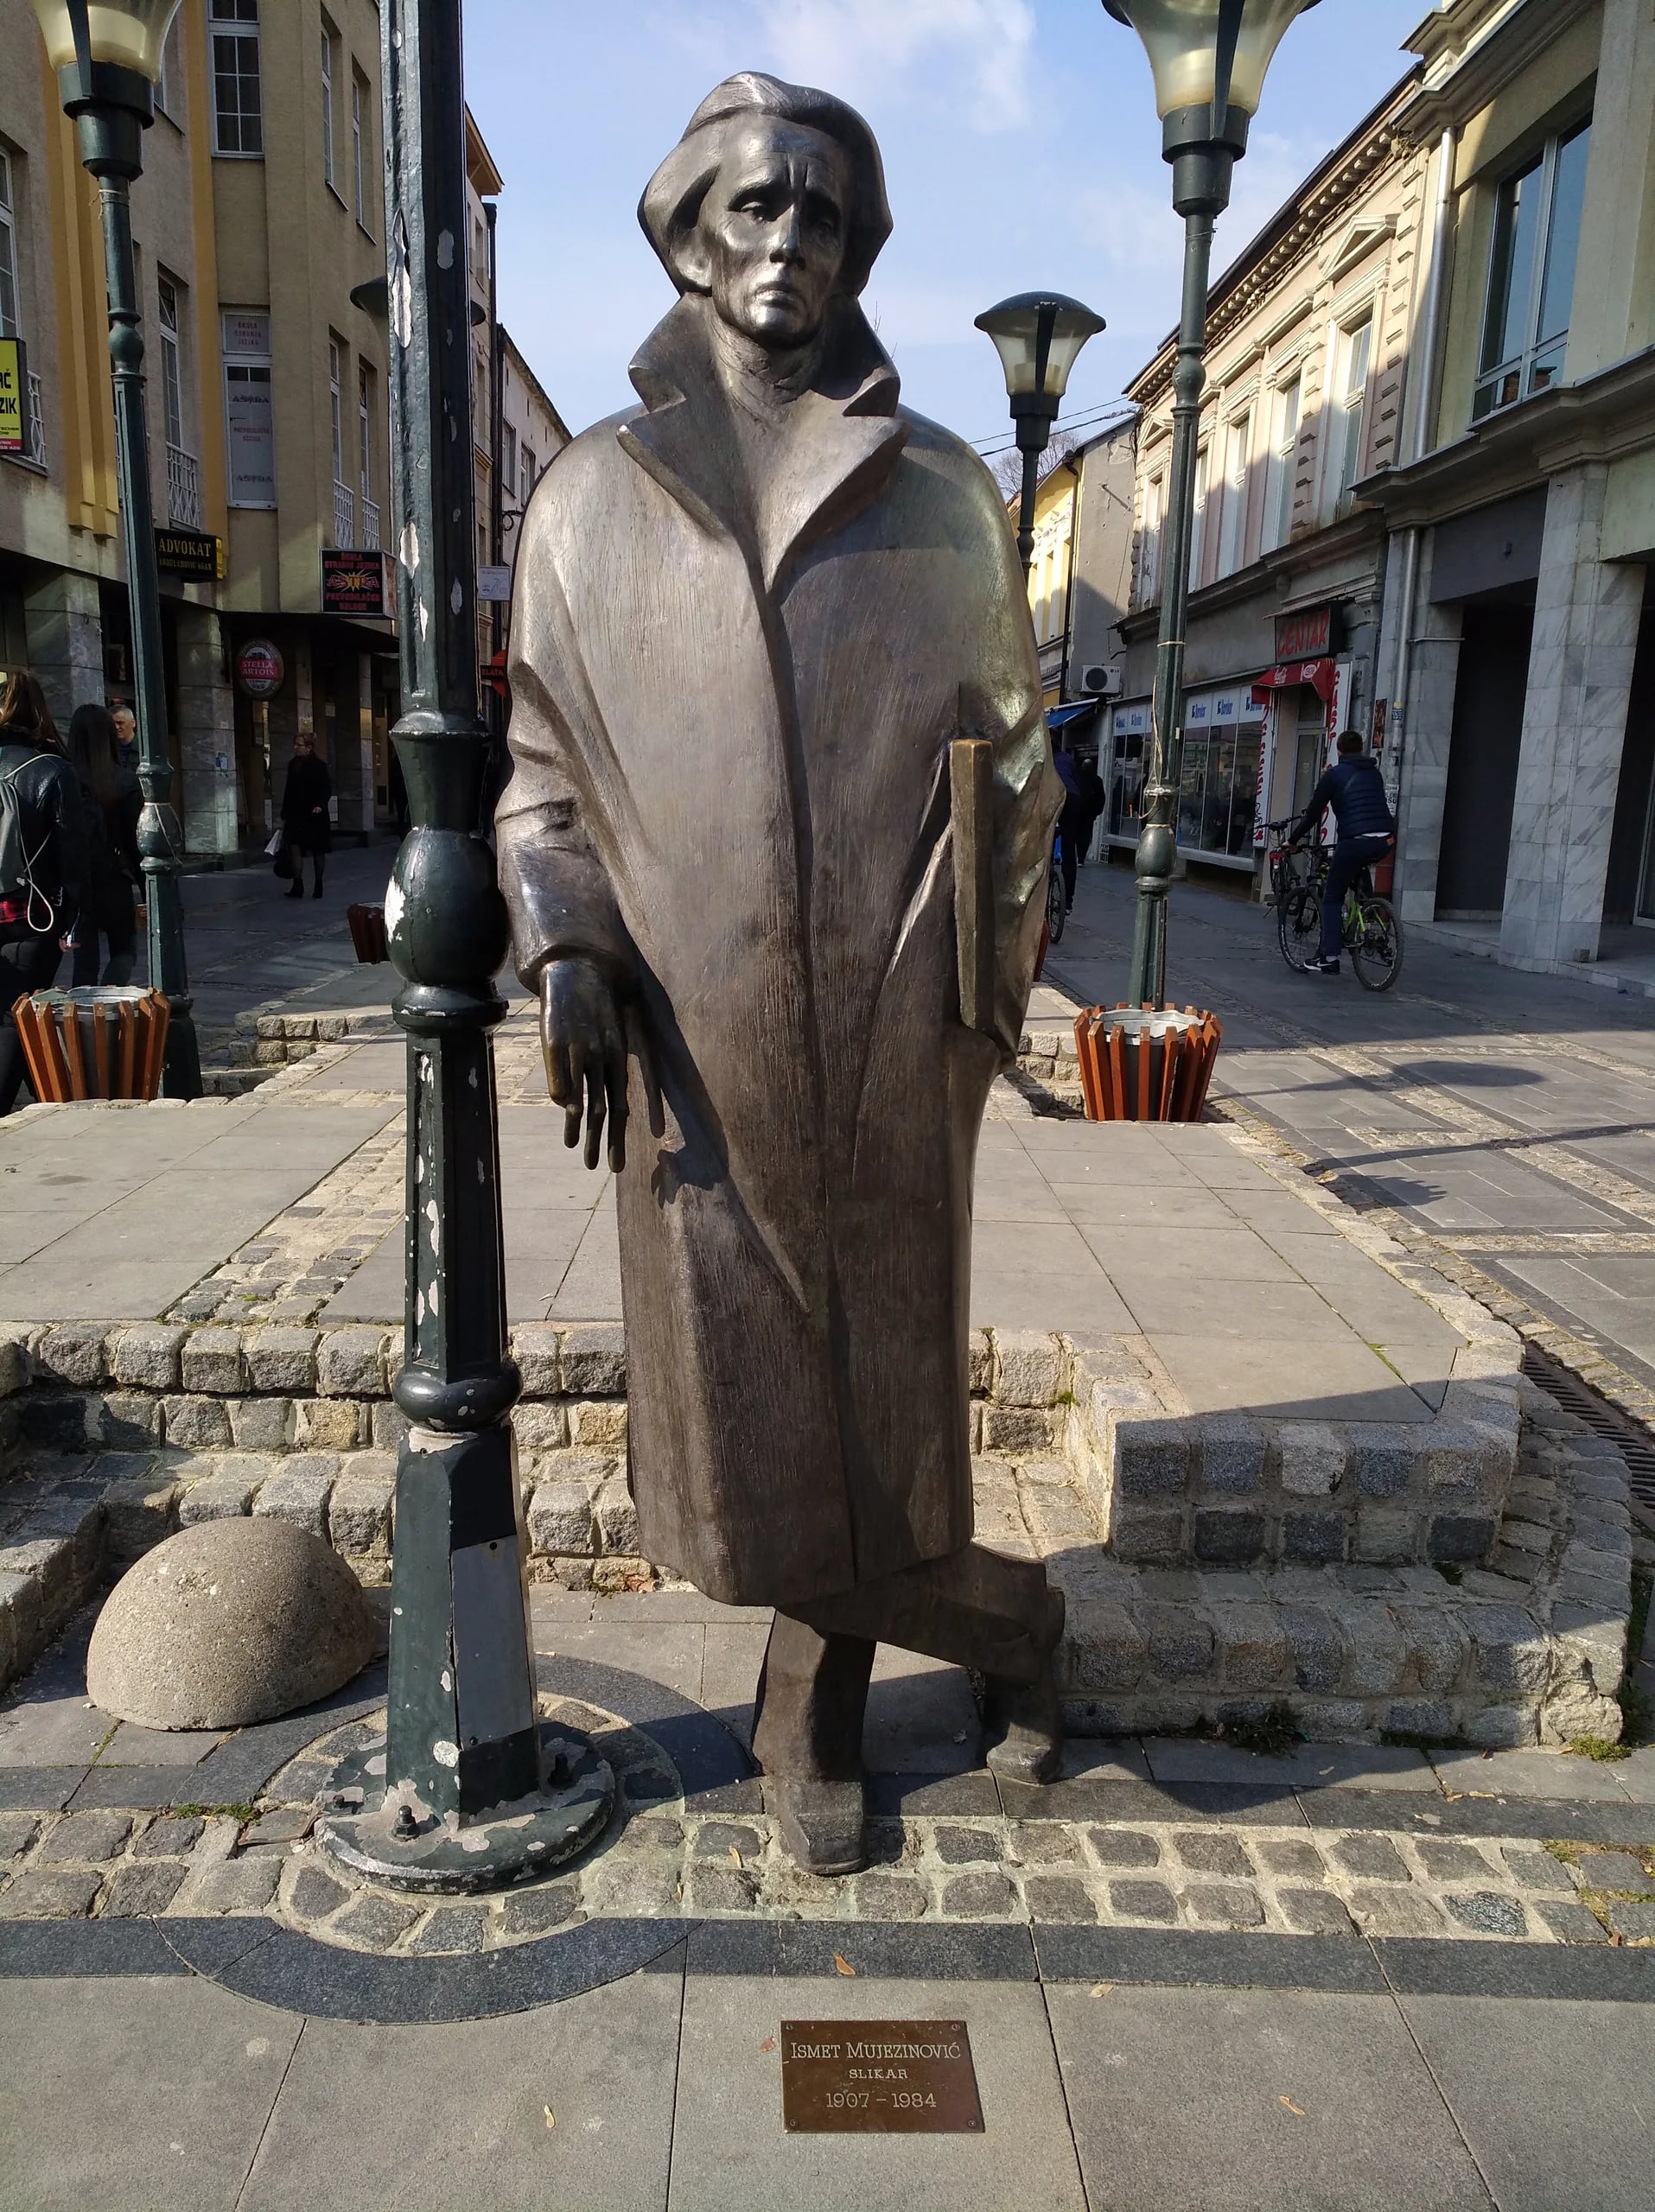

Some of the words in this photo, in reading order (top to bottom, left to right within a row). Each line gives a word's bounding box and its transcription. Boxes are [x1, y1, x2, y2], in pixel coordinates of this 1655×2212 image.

[158, 537, 212, 557] ADVOKAT
[326, 575, 380, 588] ASTRA
[1277, 608, 1331, 658] CENTAR
[791, 2043, 841, 2059] ISMET
[846, 2042, 961, 2059] MUJEZINOVIĆ
[849, 2069, 907, 2079] SLIKAR
[825, 2093, 869, 2108] 1907
[891, 2093, 937, 2108] 1984
